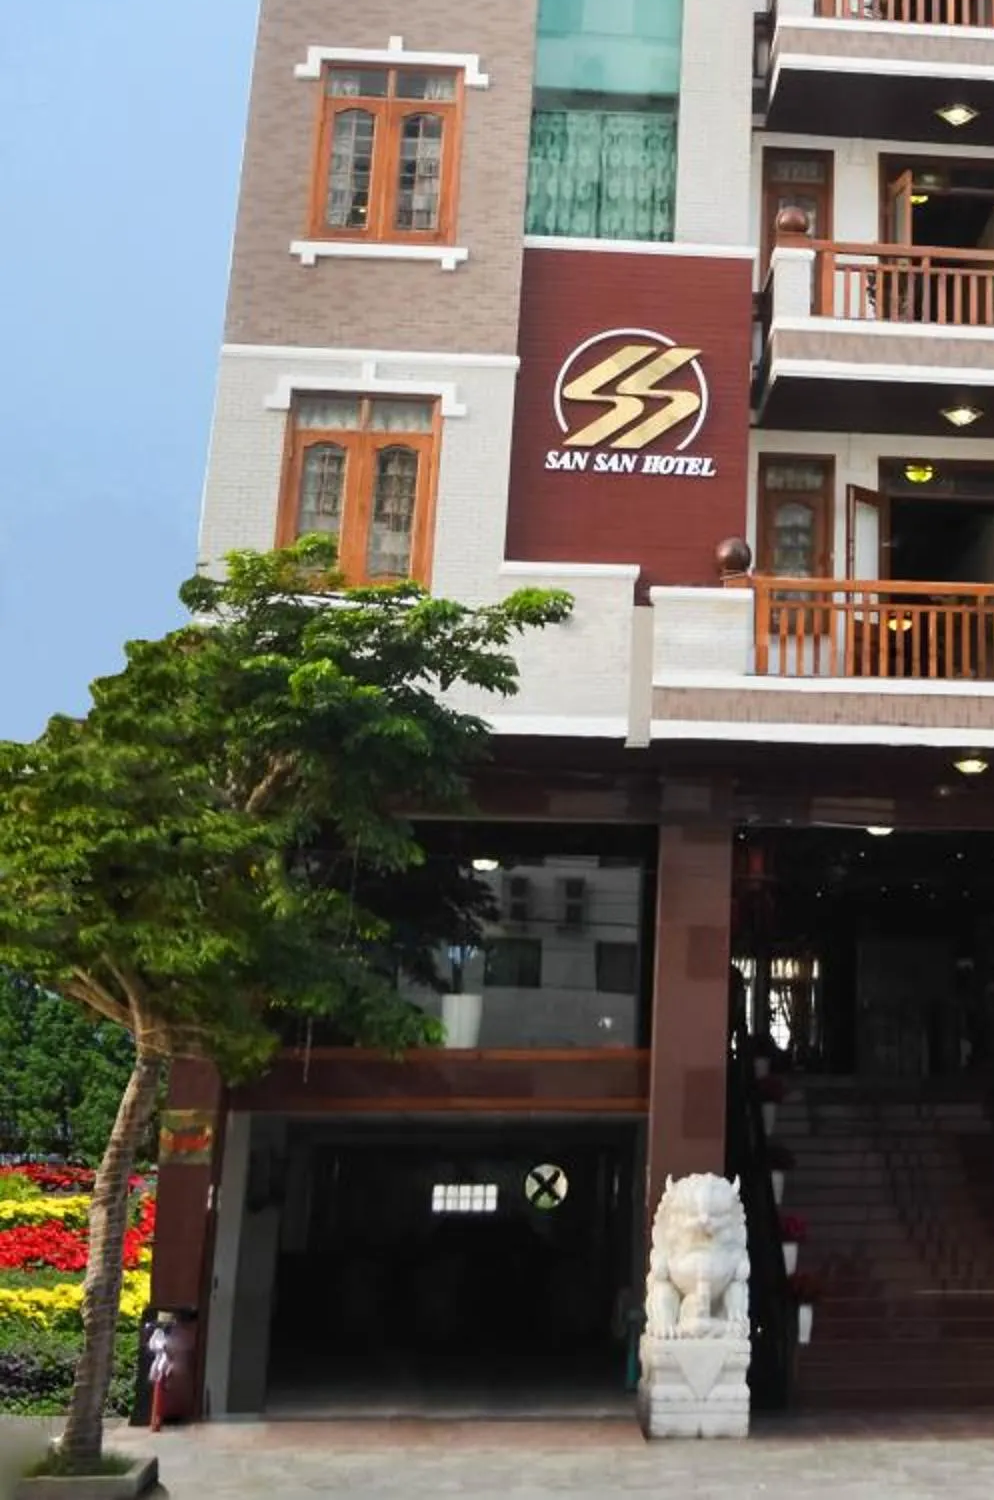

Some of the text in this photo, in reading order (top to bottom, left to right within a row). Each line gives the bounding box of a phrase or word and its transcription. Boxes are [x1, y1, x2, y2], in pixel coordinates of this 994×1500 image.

[545, 450, 716, 477] SAN SAN HOTEL
